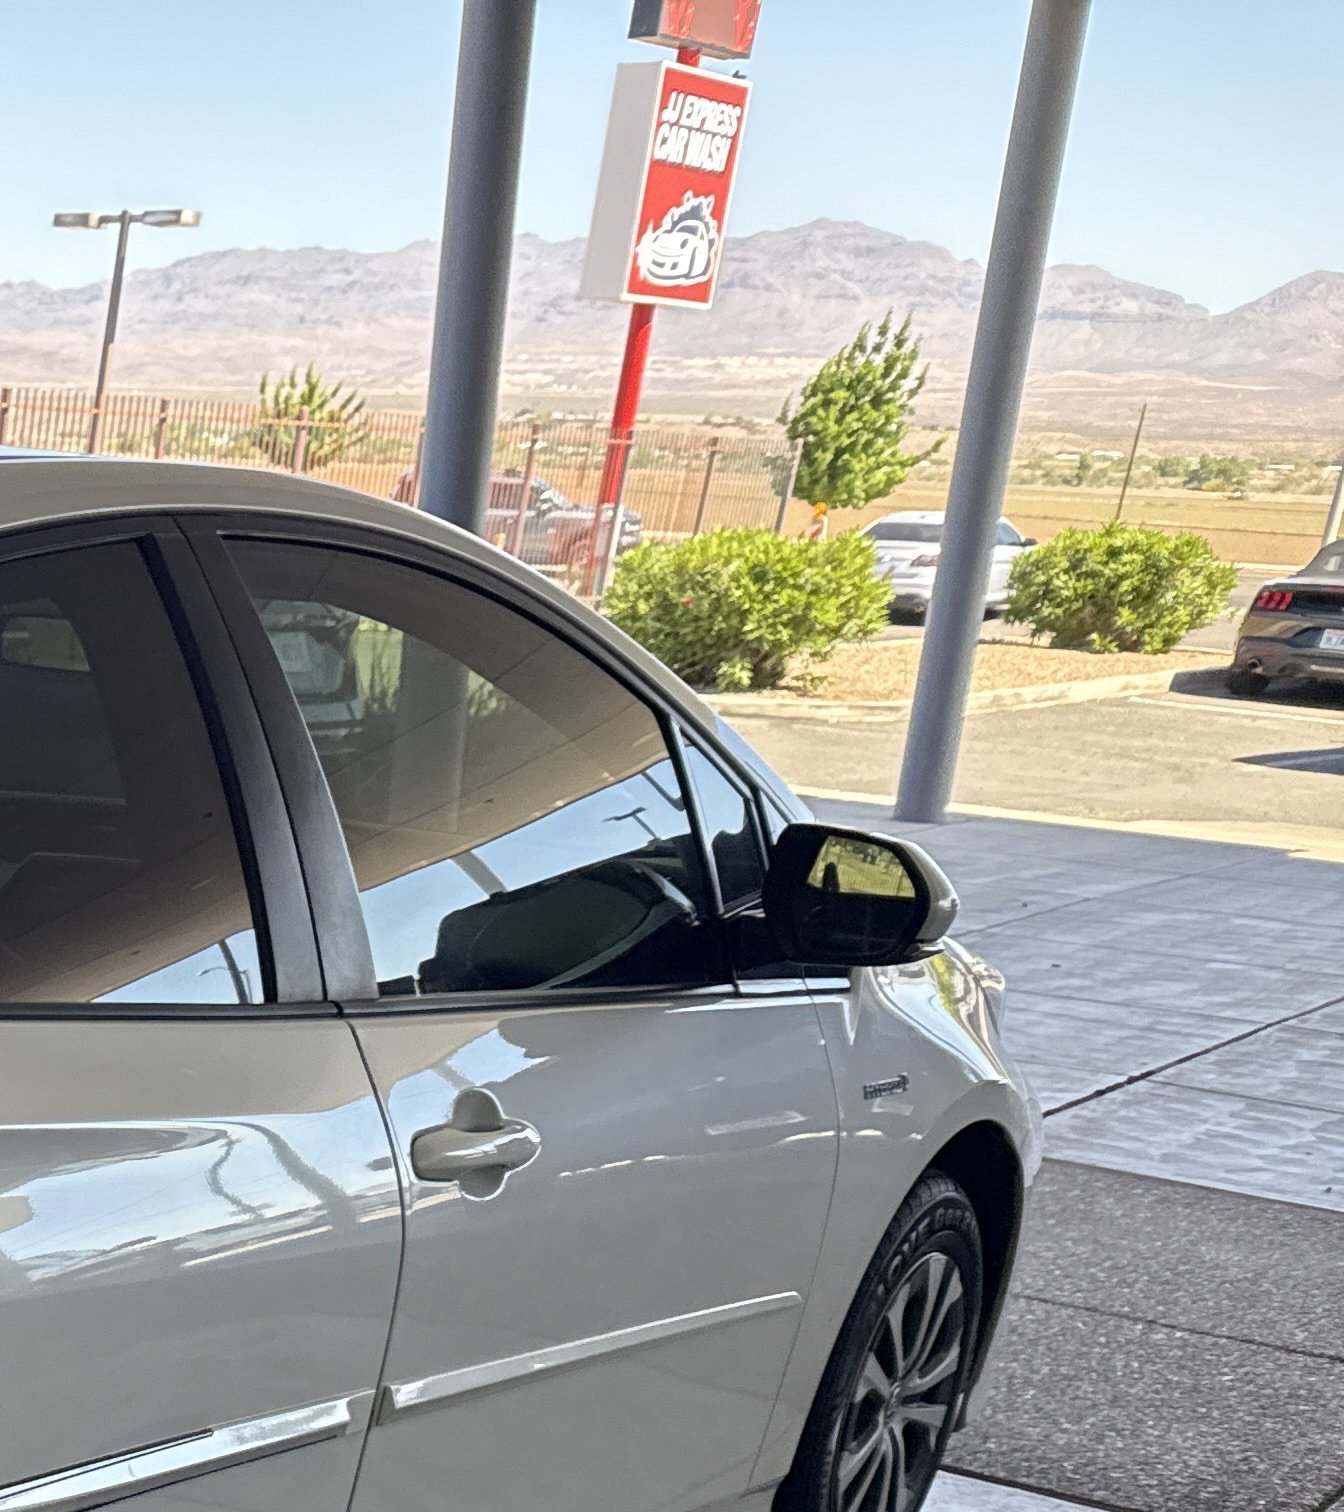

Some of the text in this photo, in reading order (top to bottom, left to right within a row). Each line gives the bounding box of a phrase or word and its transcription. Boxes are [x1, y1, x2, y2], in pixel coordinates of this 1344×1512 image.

[679, 94, 743, 137] EXPRESS
[653, 122, 734, 172] CAR WASH
